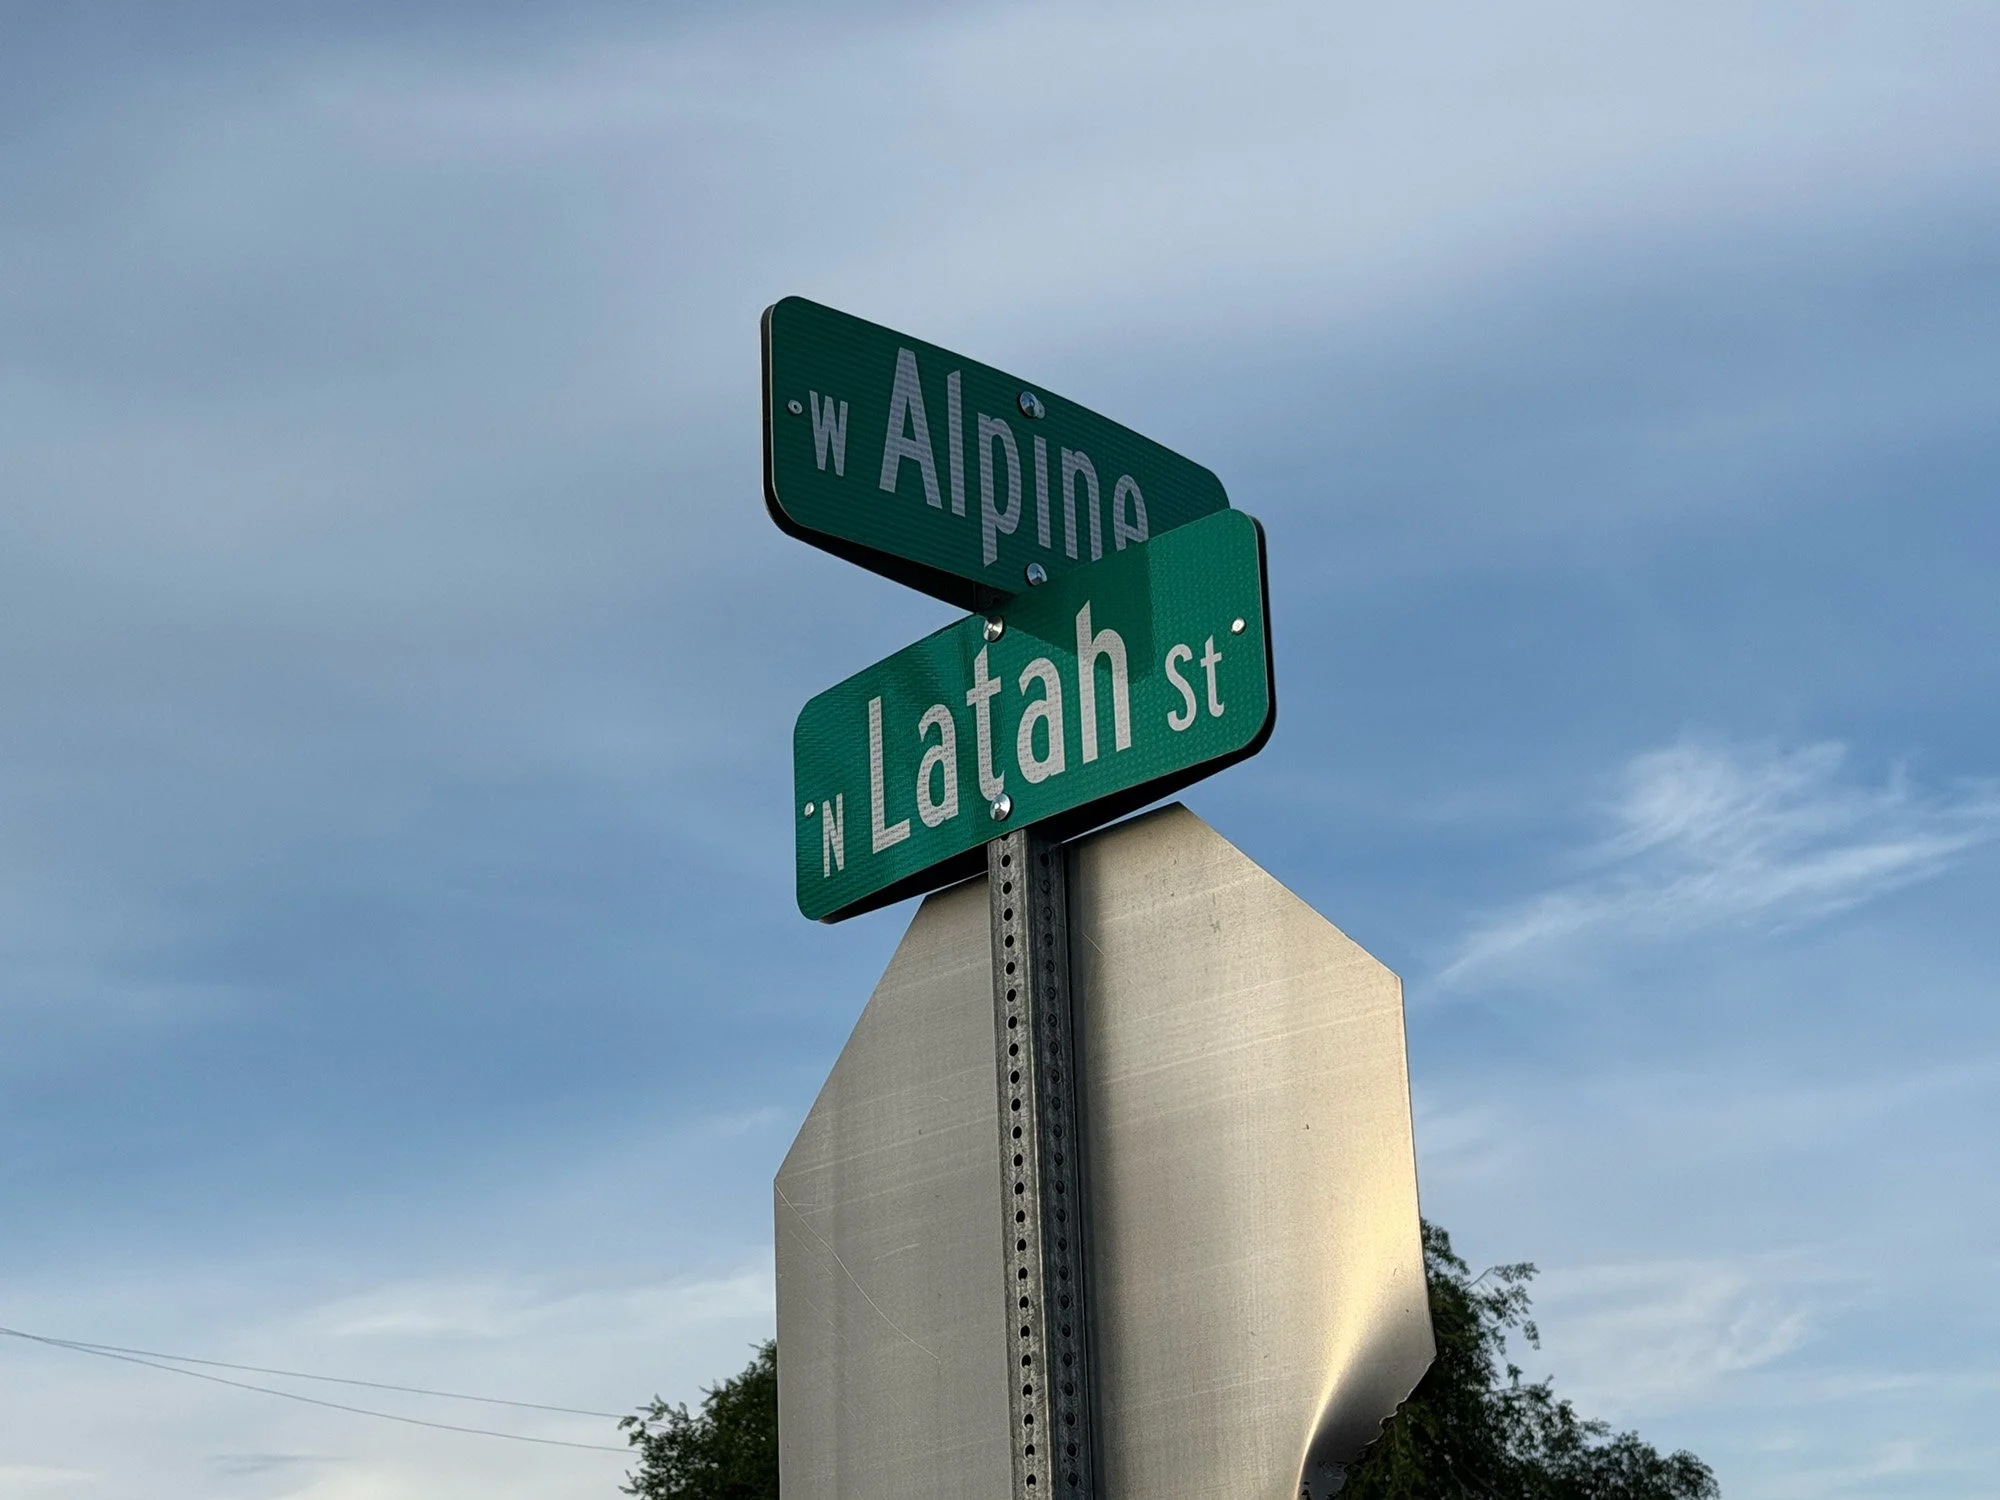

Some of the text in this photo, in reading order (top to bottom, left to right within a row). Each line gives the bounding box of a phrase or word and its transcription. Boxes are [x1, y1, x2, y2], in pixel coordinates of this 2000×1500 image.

[809, 347, 1150, 567] W Alpine
[822, 600, 1225, 878] N Latah St
